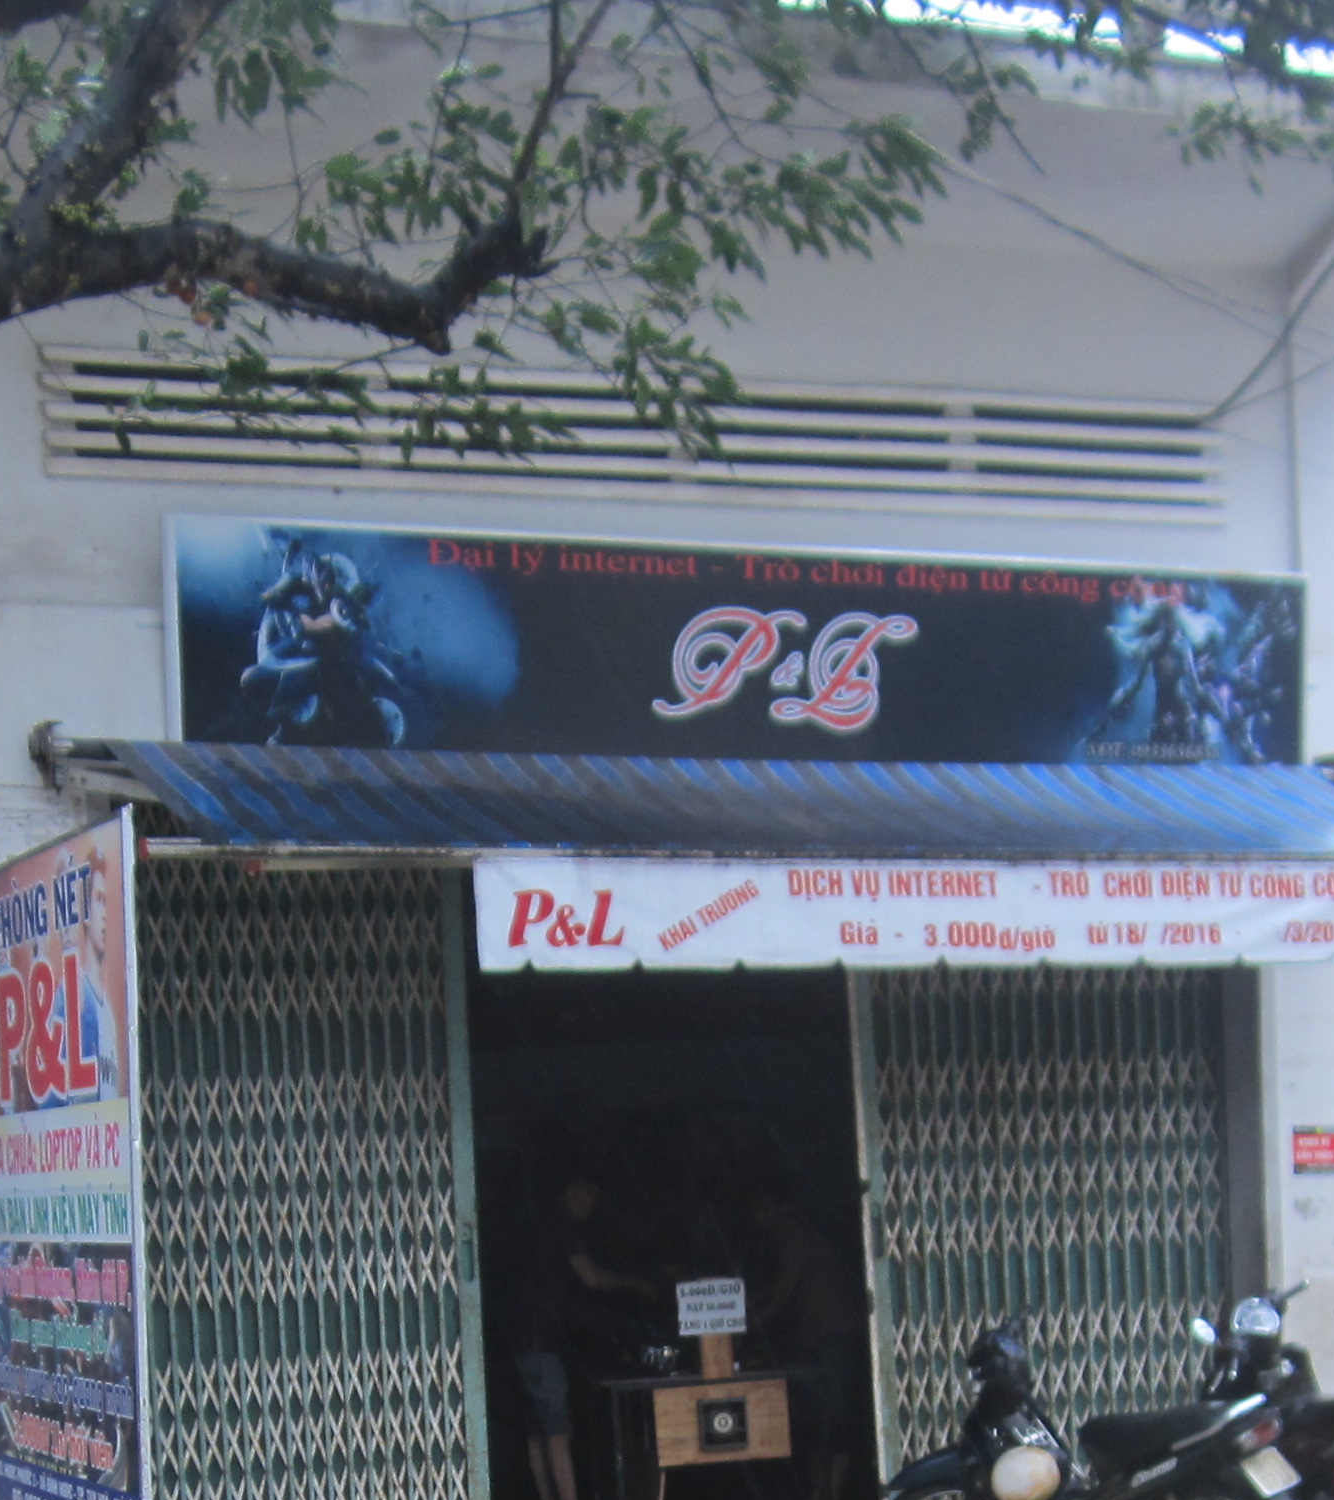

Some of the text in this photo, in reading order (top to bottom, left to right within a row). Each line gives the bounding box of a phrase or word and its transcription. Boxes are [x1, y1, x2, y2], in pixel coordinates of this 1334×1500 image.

[428, 538, 496, 572] Đại
[509, 543, 544, 575] lý
[558, 544, 699, 577] internet
[735, 553, 800, 582] Trò
[810, 559, 884, 587] chơi
[896, 563, 967, 593] điện
[978, 567, 1012, 593] tử
[1021, 570, 1101, 603] công
[788, 868, 843, 902] DỊCH
[851, 868, 881, 902] VỤ
[888, 869, 997, 897] INTERNET
[1103, 868, 1153, 898] CHƠI
[1161, 866, 1210, 902] ĐIỆN
[508, 888, 624, 948] P&L
[657, 915, 698, 952] KHAI
[839, 918, 879, 945] Giá
[40, 1126, 82, 1172] LOPTOP
[85, 1112, 100, 1169] VÀ
[105, 1122, 120, 1168] PC
